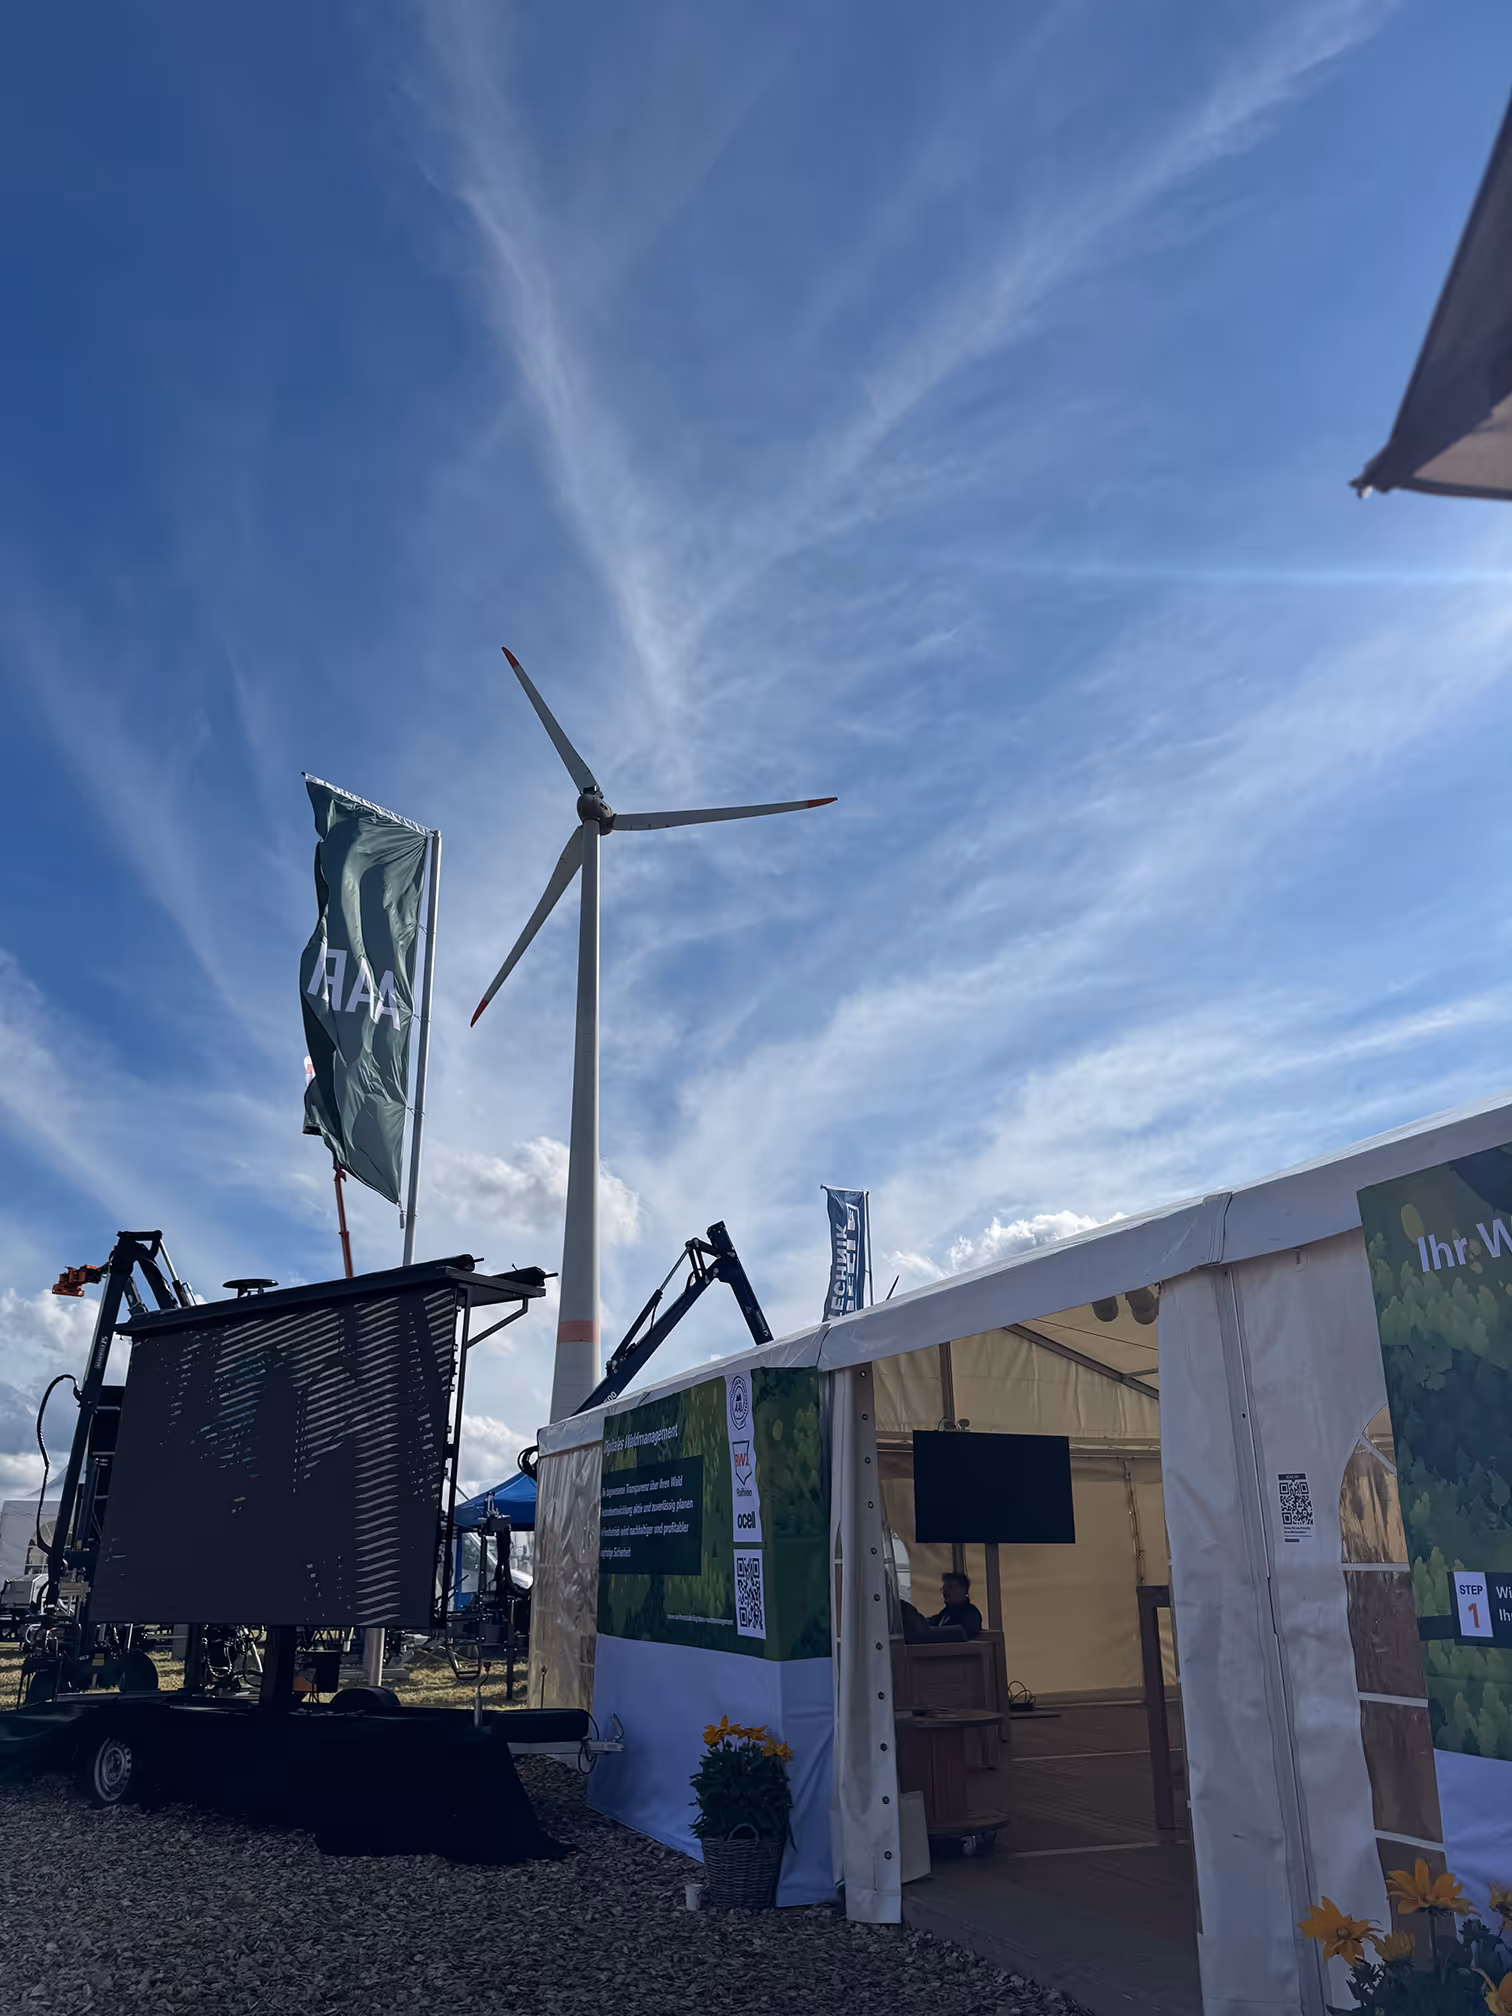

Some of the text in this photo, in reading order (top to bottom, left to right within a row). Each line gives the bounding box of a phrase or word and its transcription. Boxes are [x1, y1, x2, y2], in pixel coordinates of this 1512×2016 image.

[1417, 1234, 1467, 1272] Ihr
[625, 1423, 678, 1448] Waldmanagement
[676, 1498, 694, 1512] planen
[737, 1510, 757, 1529] ocell
[1460, 1585, 1483, 1595] STEP
[1468, 1603, 1480, 1628] 1
